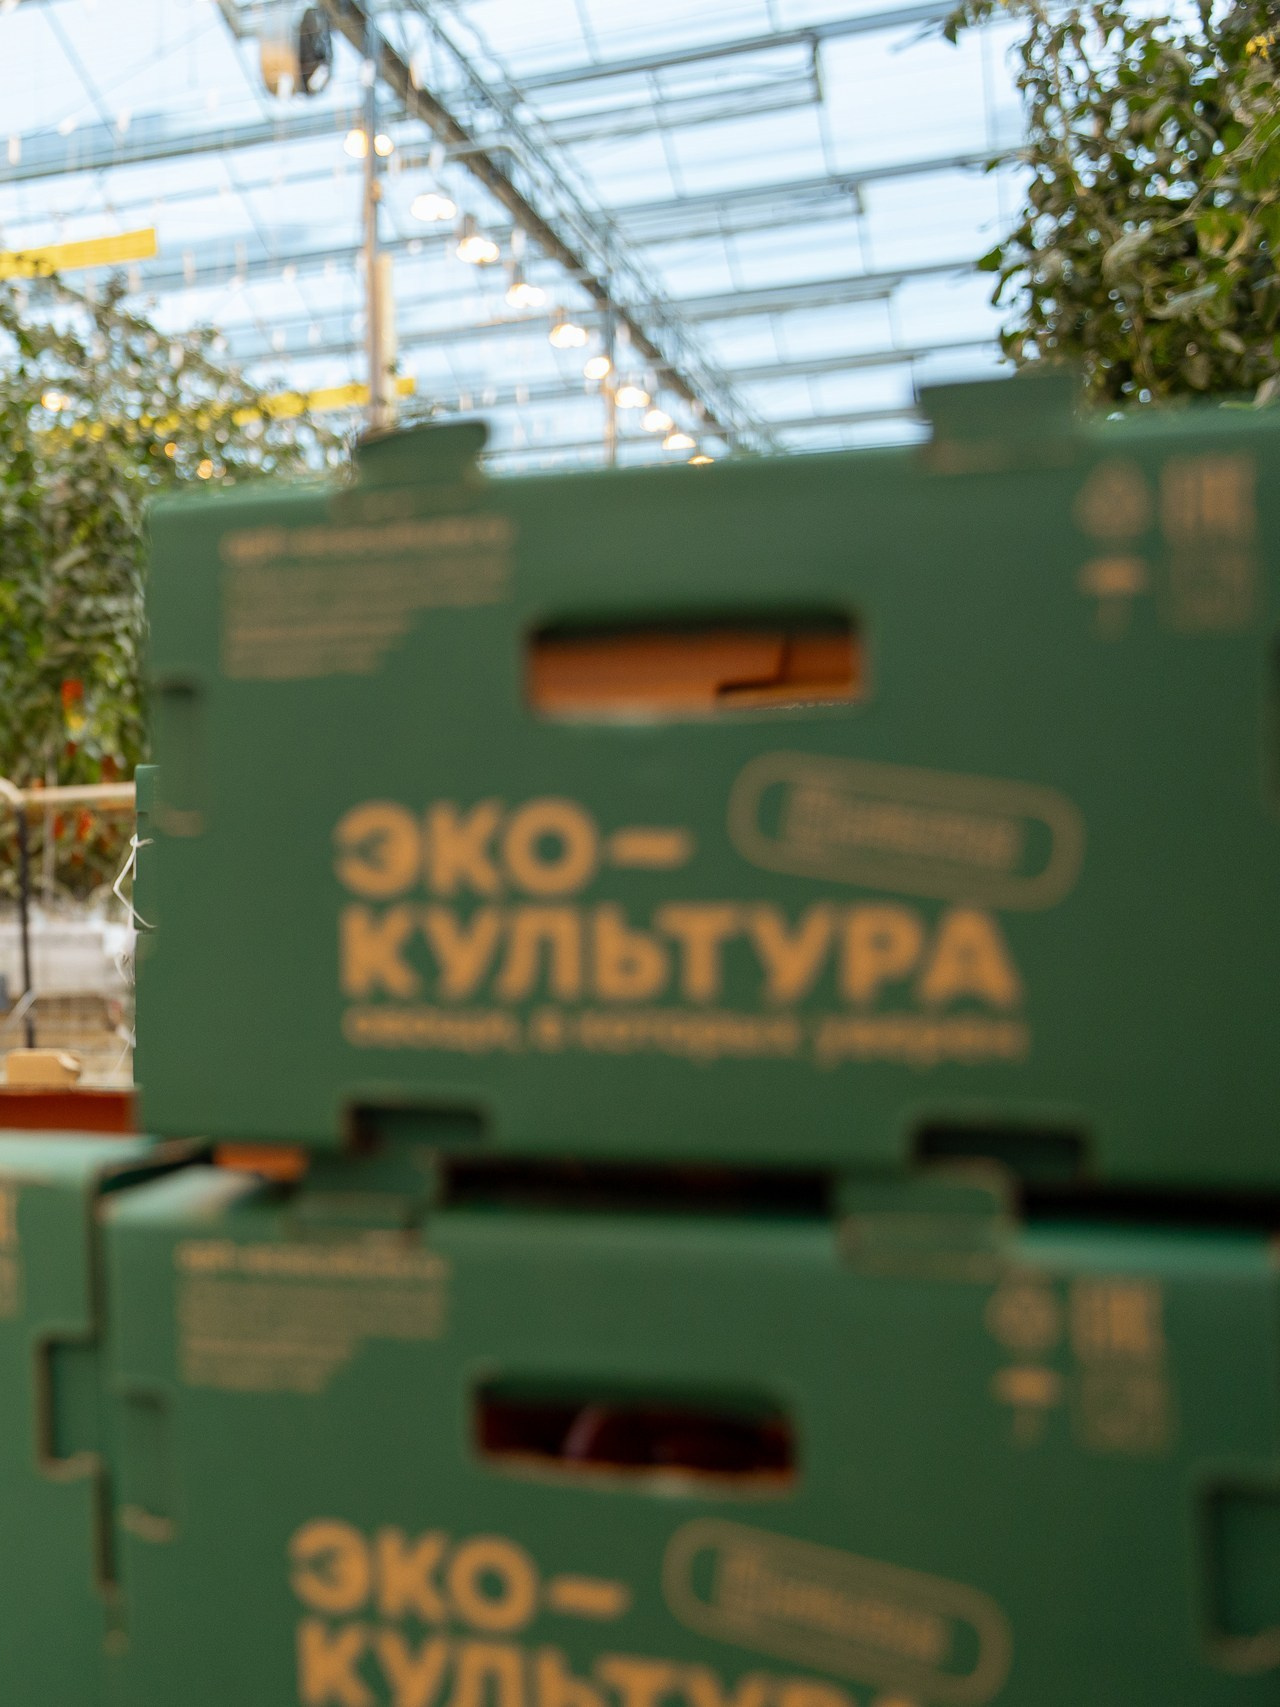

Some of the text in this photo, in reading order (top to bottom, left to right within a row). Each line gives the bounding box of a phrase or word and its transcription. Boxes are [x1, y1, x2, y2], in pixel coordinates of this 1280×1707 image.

[335, 798, 692, 899] ЭКО-
[339, 901, 1022, 1009] КУЛЬТУРА
[290, 1518, 629, 1633] ЭКО-
